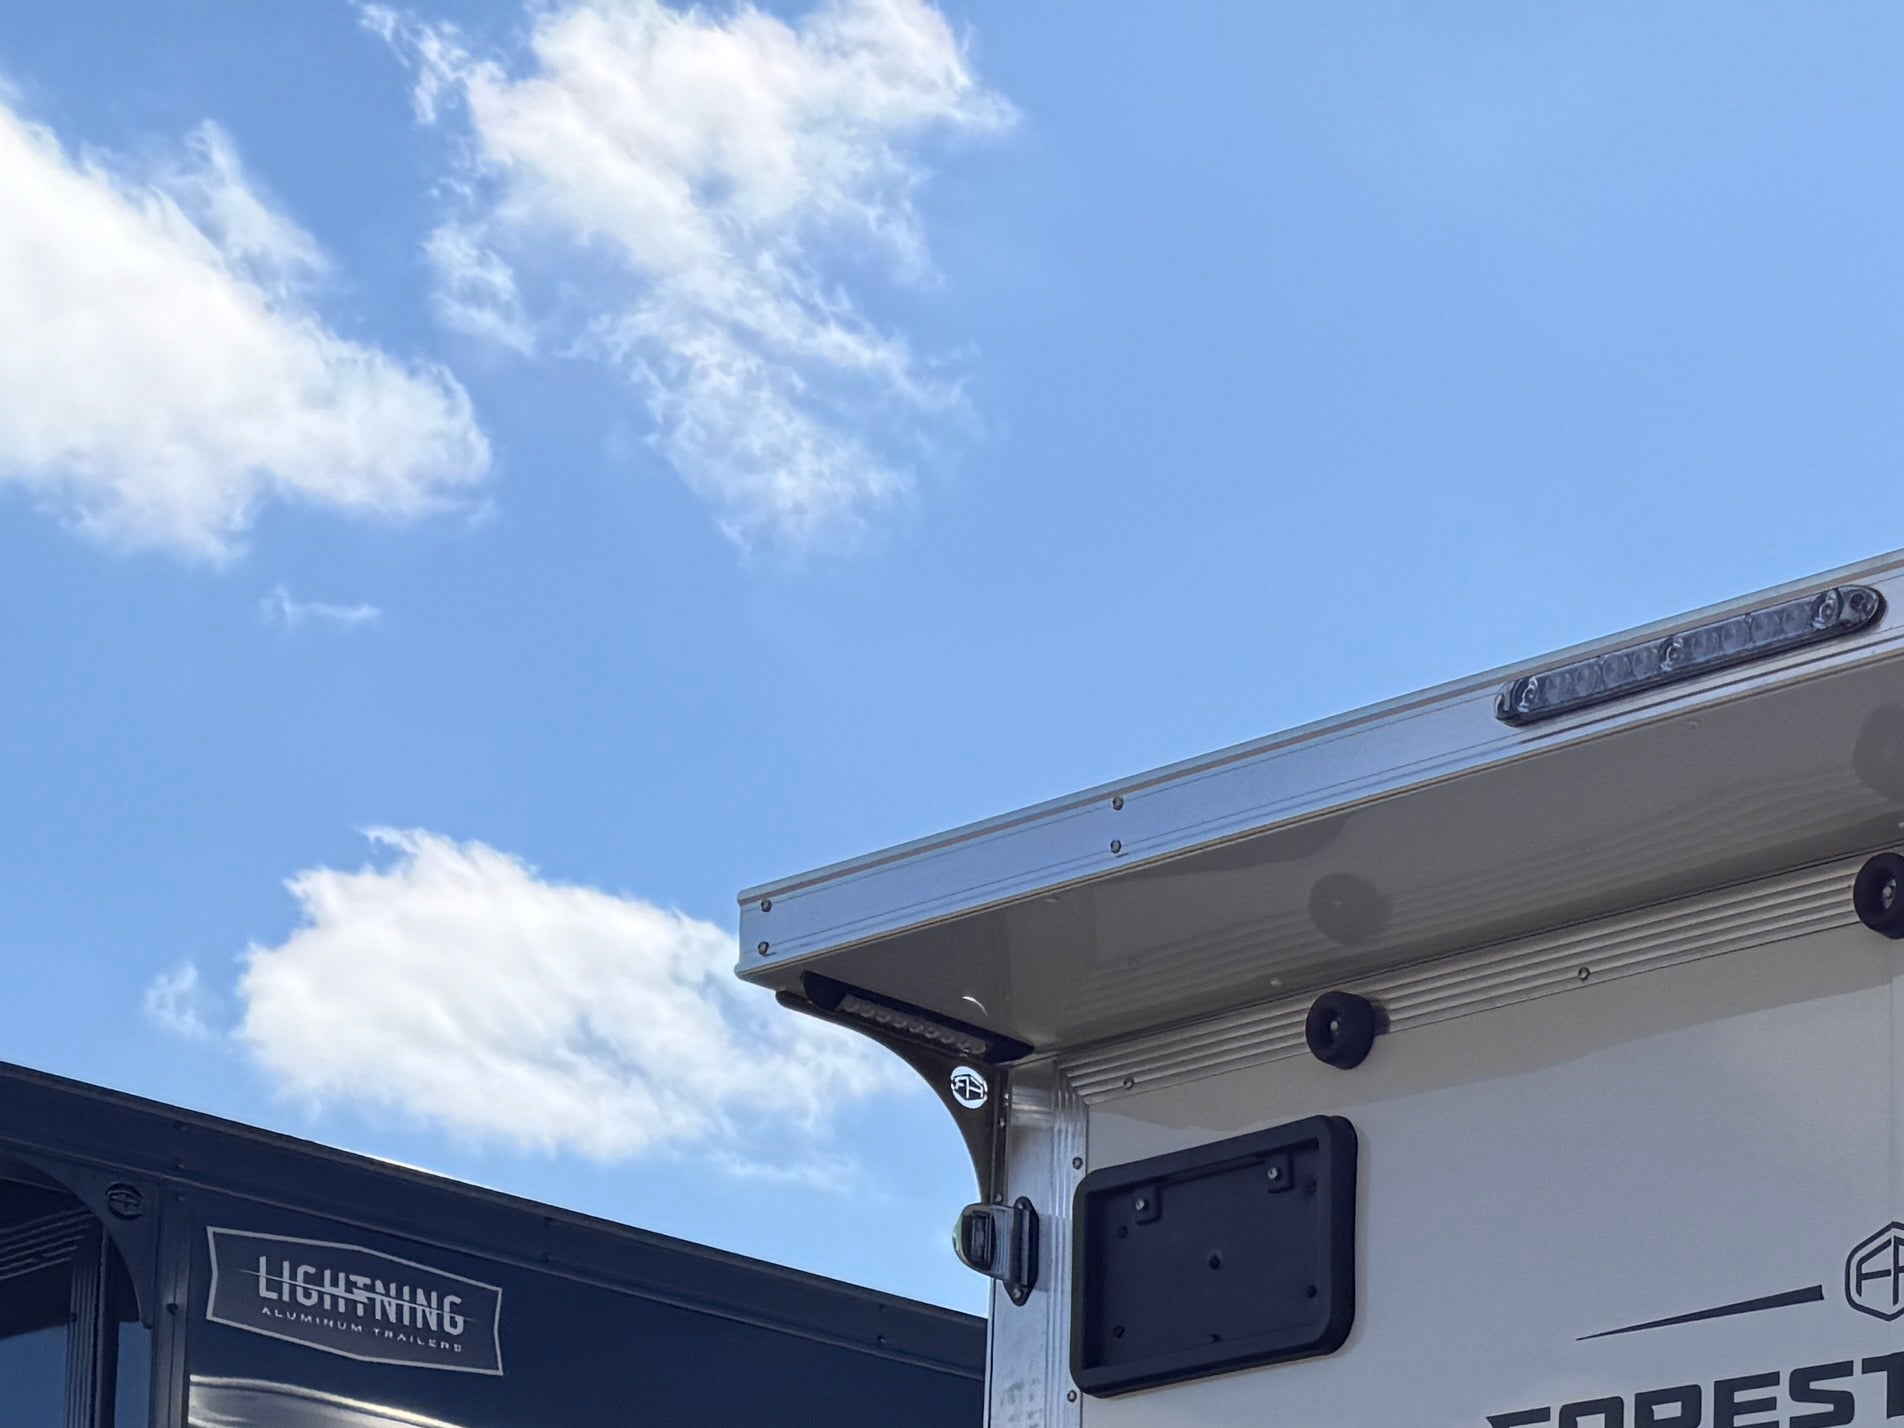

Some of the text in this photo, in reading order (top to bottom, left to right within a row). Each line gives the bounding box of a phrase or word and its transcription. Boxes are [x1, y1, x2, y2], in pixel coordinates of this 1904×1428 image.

[257, 1255, 465, 1336] LIGHTNING
[261, 1306, 364, 1333] ALUMINUM
[372, 1327, 463, 1353] TRAILERS
